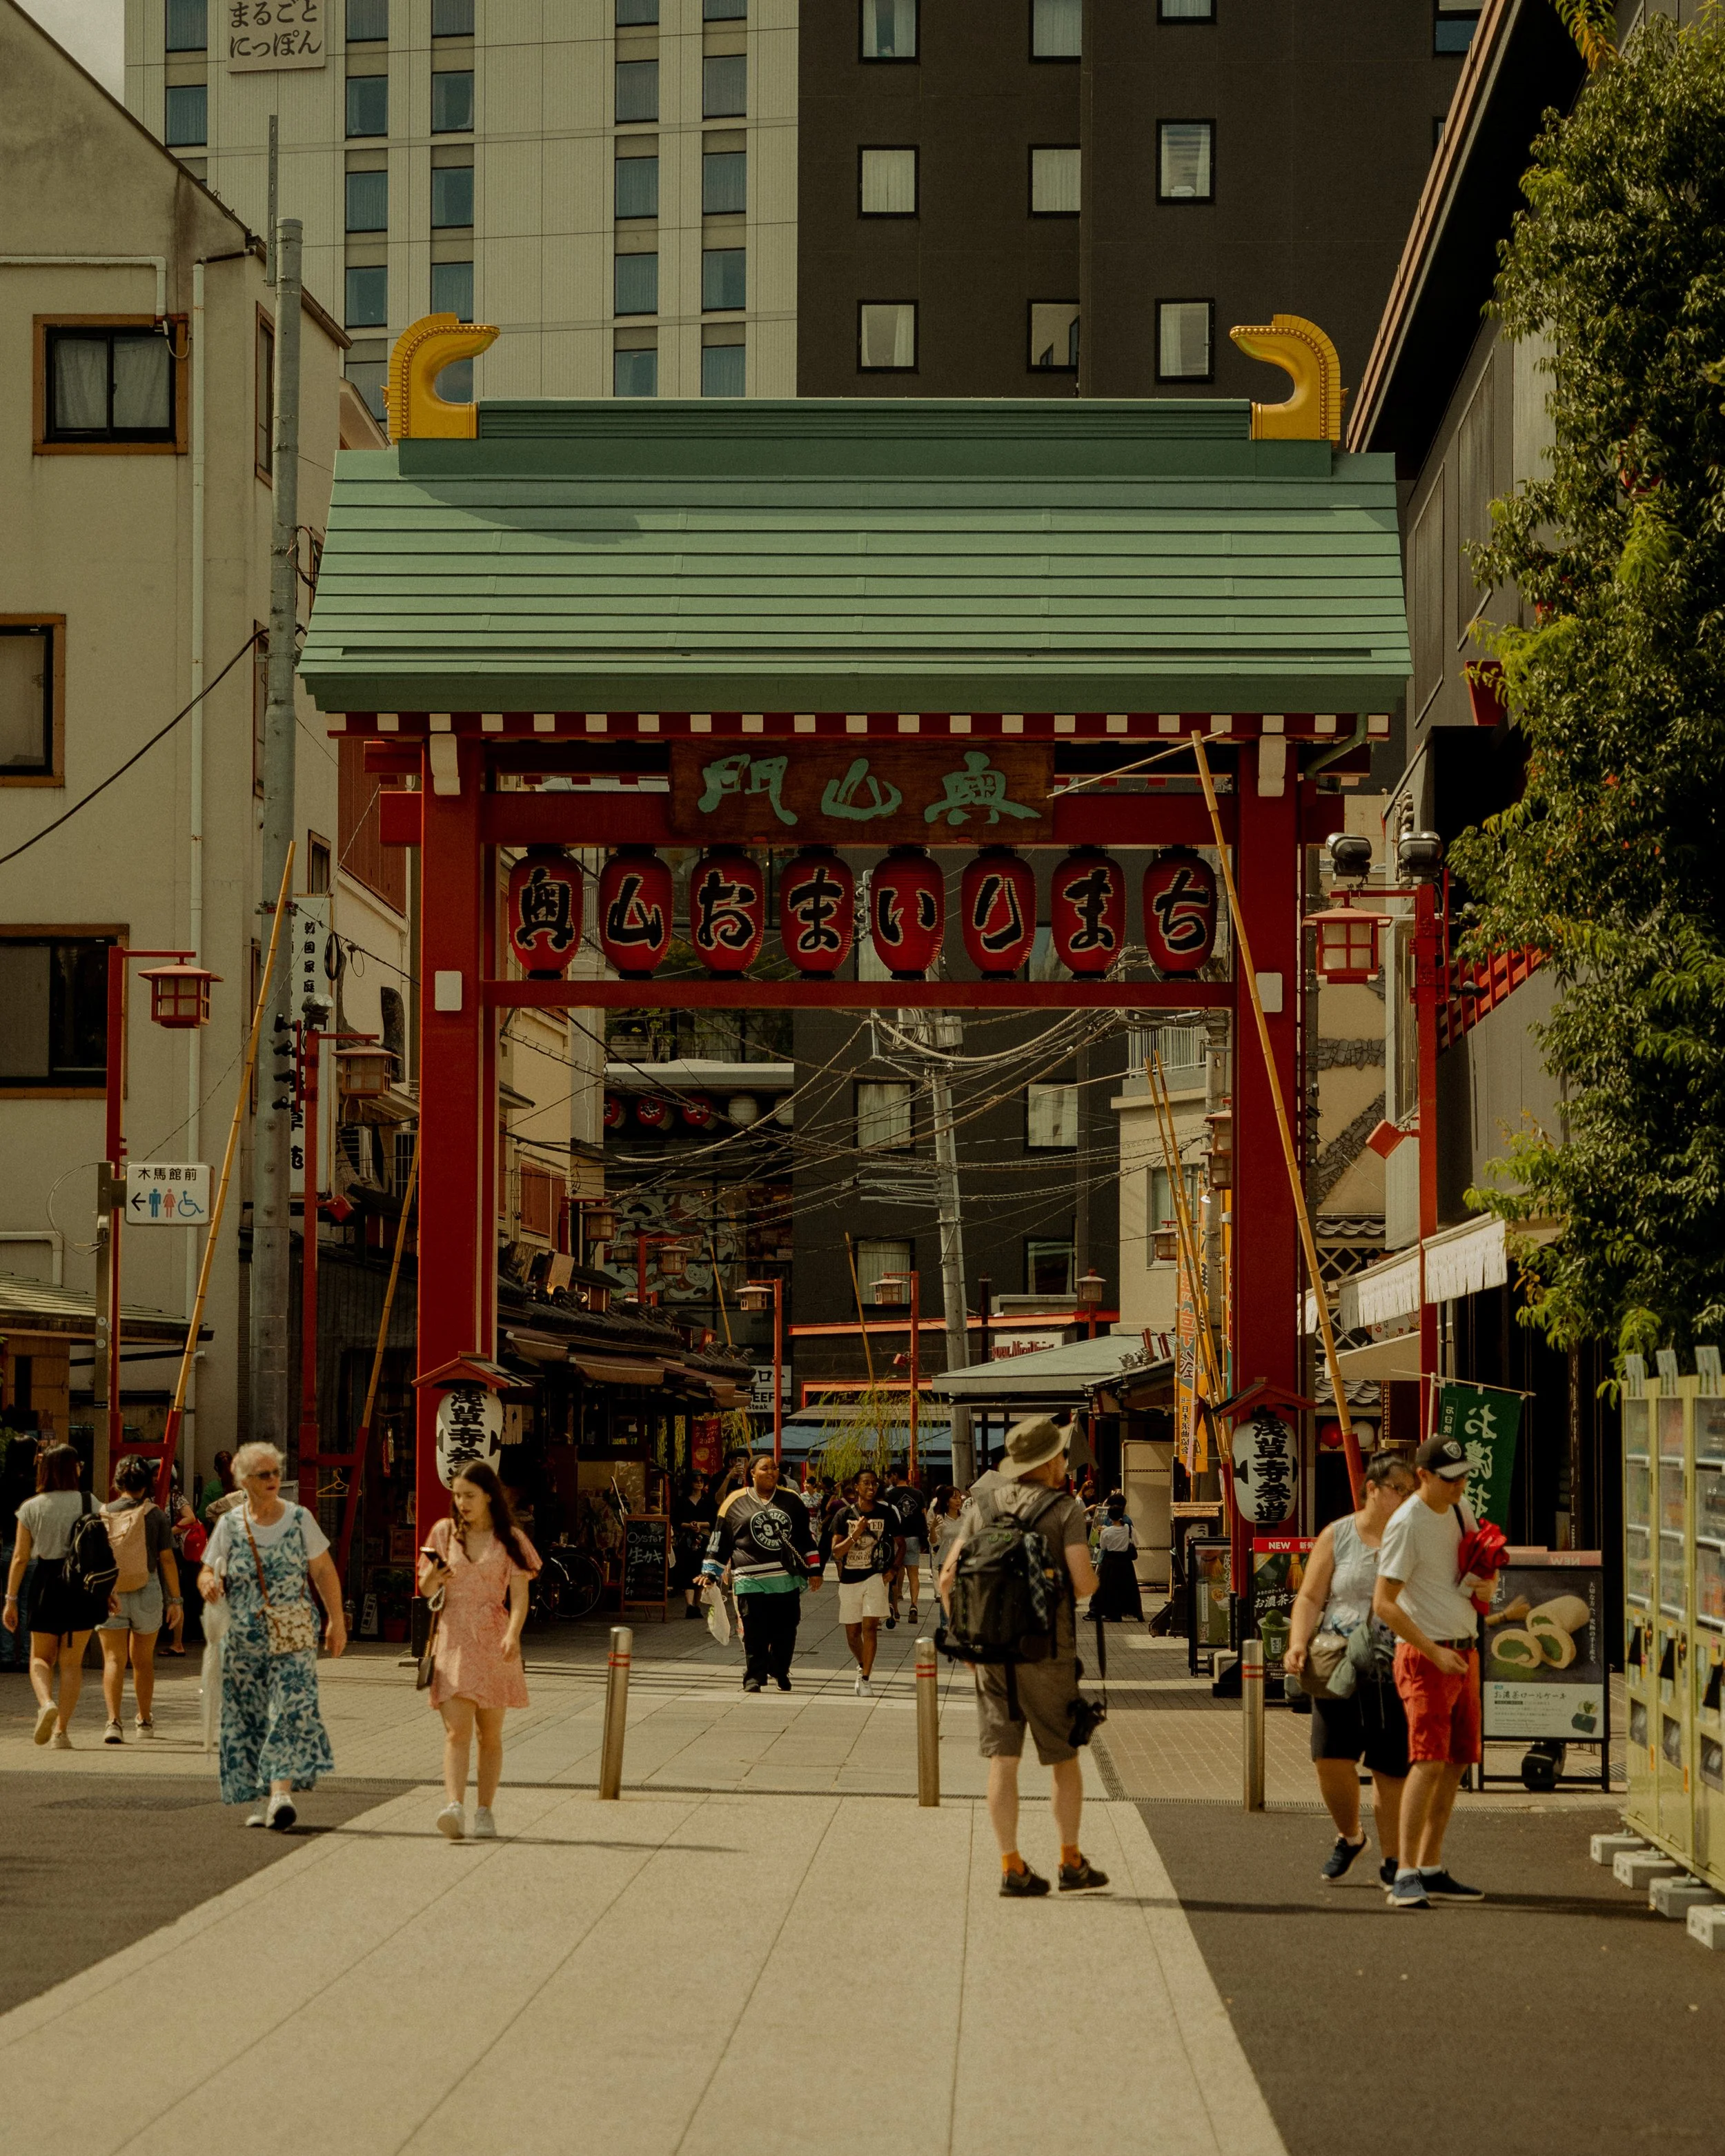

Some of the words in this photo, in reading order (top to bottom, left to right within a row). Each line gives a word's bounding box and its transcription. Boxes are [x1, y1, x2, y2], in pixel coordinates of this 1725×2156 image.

[229, 0, 317, 28] まるごと
[229, 29, 322, 59] にっぽん
[138, 1167, 197, 1180] 木馬館前
[751, 1392, 775, 1403] EEF
[446, 1389, 489, 1489] 浅草寺参
[1252, 1419, 1292, 1521] 浅草寺参道
[627, 1532, 665, 1545] Oyster
[1268, 1541, 1291, 1550] NEW
[628, 1547, 664, 1565] 生カキ
